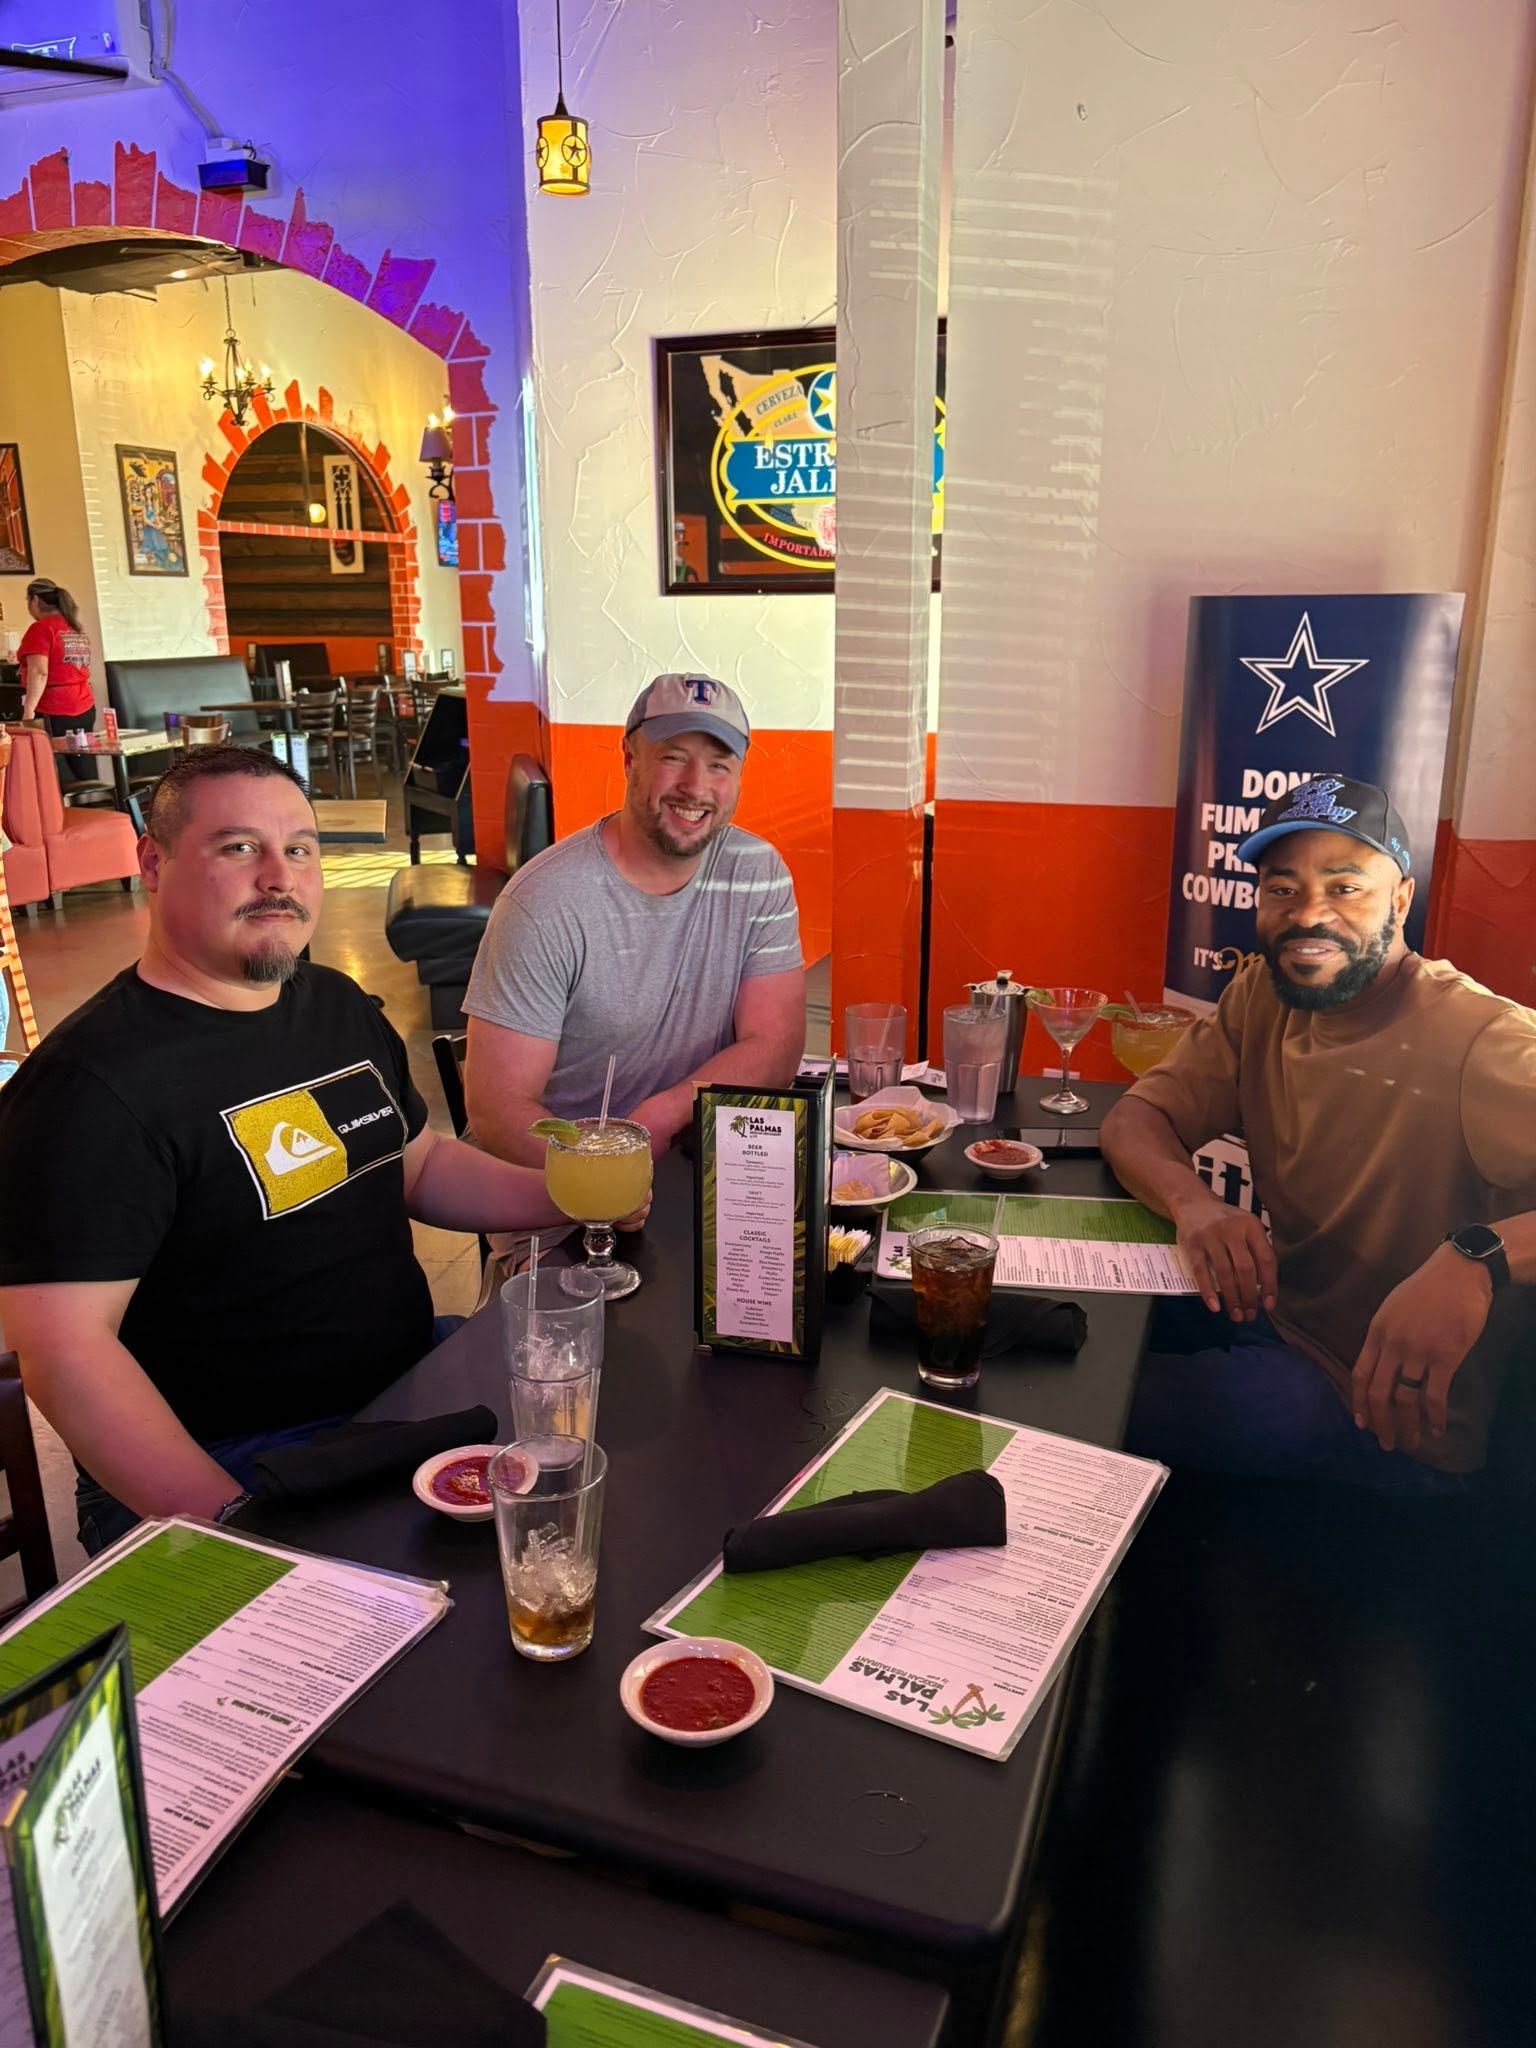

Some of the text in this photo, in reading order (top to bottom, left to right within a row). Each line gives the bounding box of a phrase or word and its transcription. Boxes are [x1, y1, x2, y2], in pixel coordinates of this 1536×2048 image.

[755, 384, 804, 416] CERVEZA
[753, 441, 836, 470] ESTR
[769, 468, 836, 496] JALI
[685, 679, 718, 706] T
[1200, 802, 1266, 835] FUM
[1182, 872, 1260, 910] COWB
[1193, 947, 1223, 971] IT'S
[749, 1116, 765, 1125] LAS
[749, 1124, 782, 1134] PALMAS
[739, 1235, 771, 1243] COCKTAILS
[743, 1229, 767, 1237] CLASSIC
[849, 1660, 939, 1700] PALMAS
[855, 1654, 908, 1681] RESTAURANT
[907, 1672, 945, 1691] MEXICAN
[884, 1689, 930, 1713] LAS
